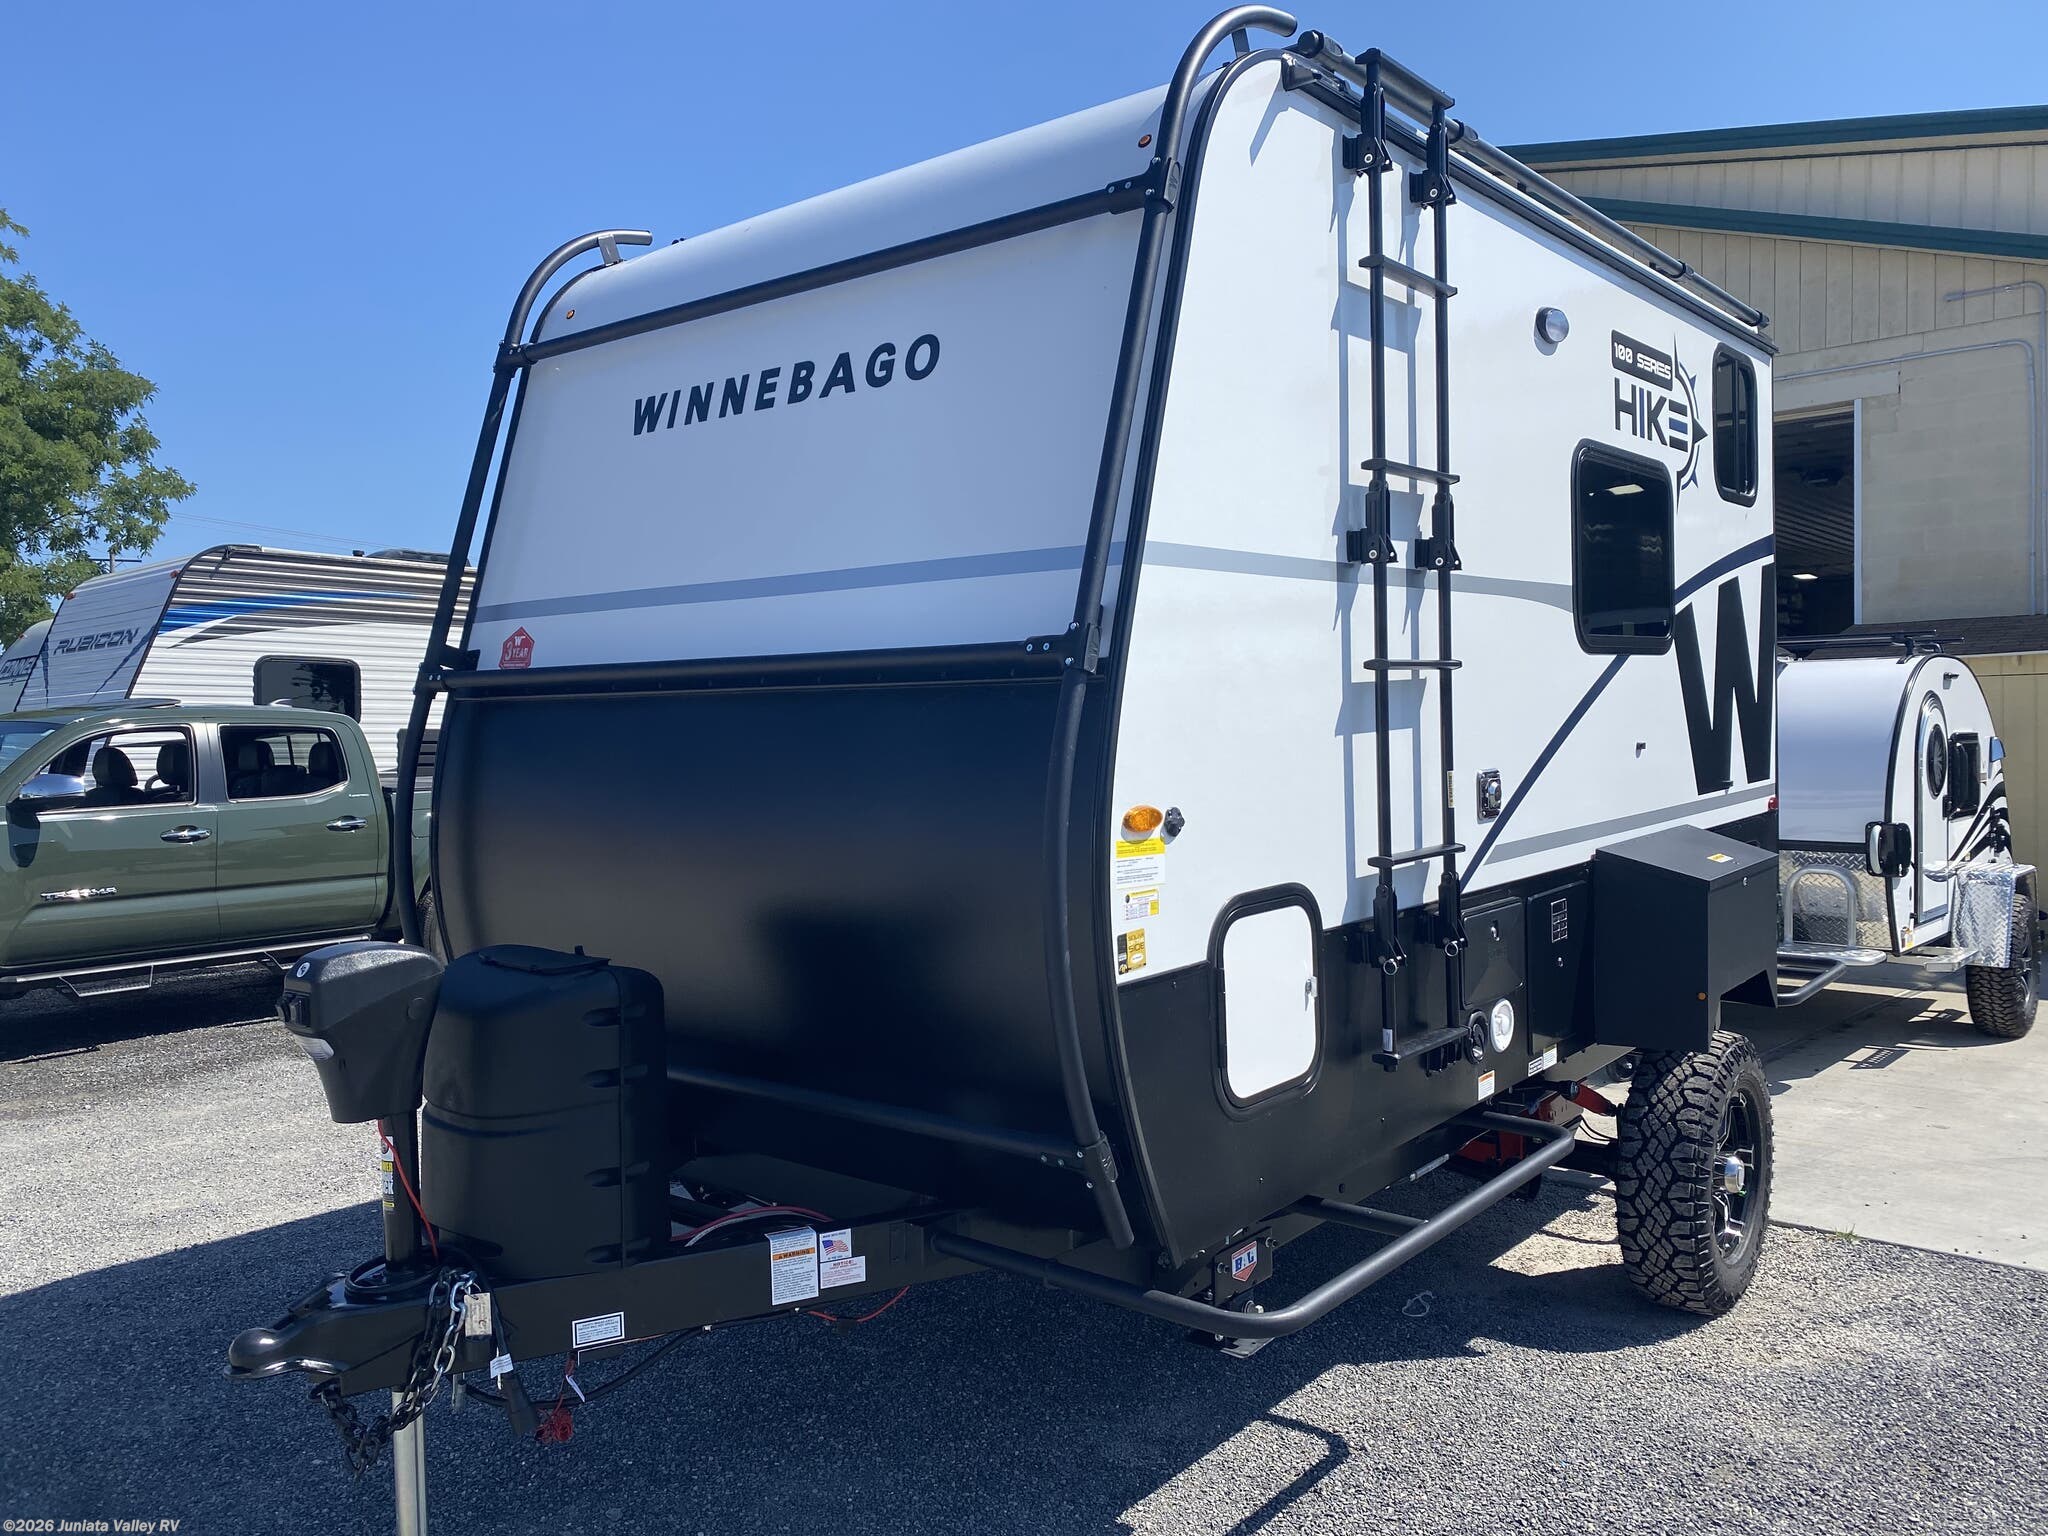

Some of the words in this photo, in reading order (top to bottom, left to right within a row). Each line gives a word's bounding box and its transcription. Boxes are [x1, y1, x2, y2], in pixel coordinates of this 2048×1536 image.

[633, 333, 940, 436] WINNEBAGO
[1613, 342, 1634, 364] 100
[1614, 376, 1689, 453] HIKE
[53, 627, 140, 656] RUBICON
[1675, 562, 1775, 796] W
